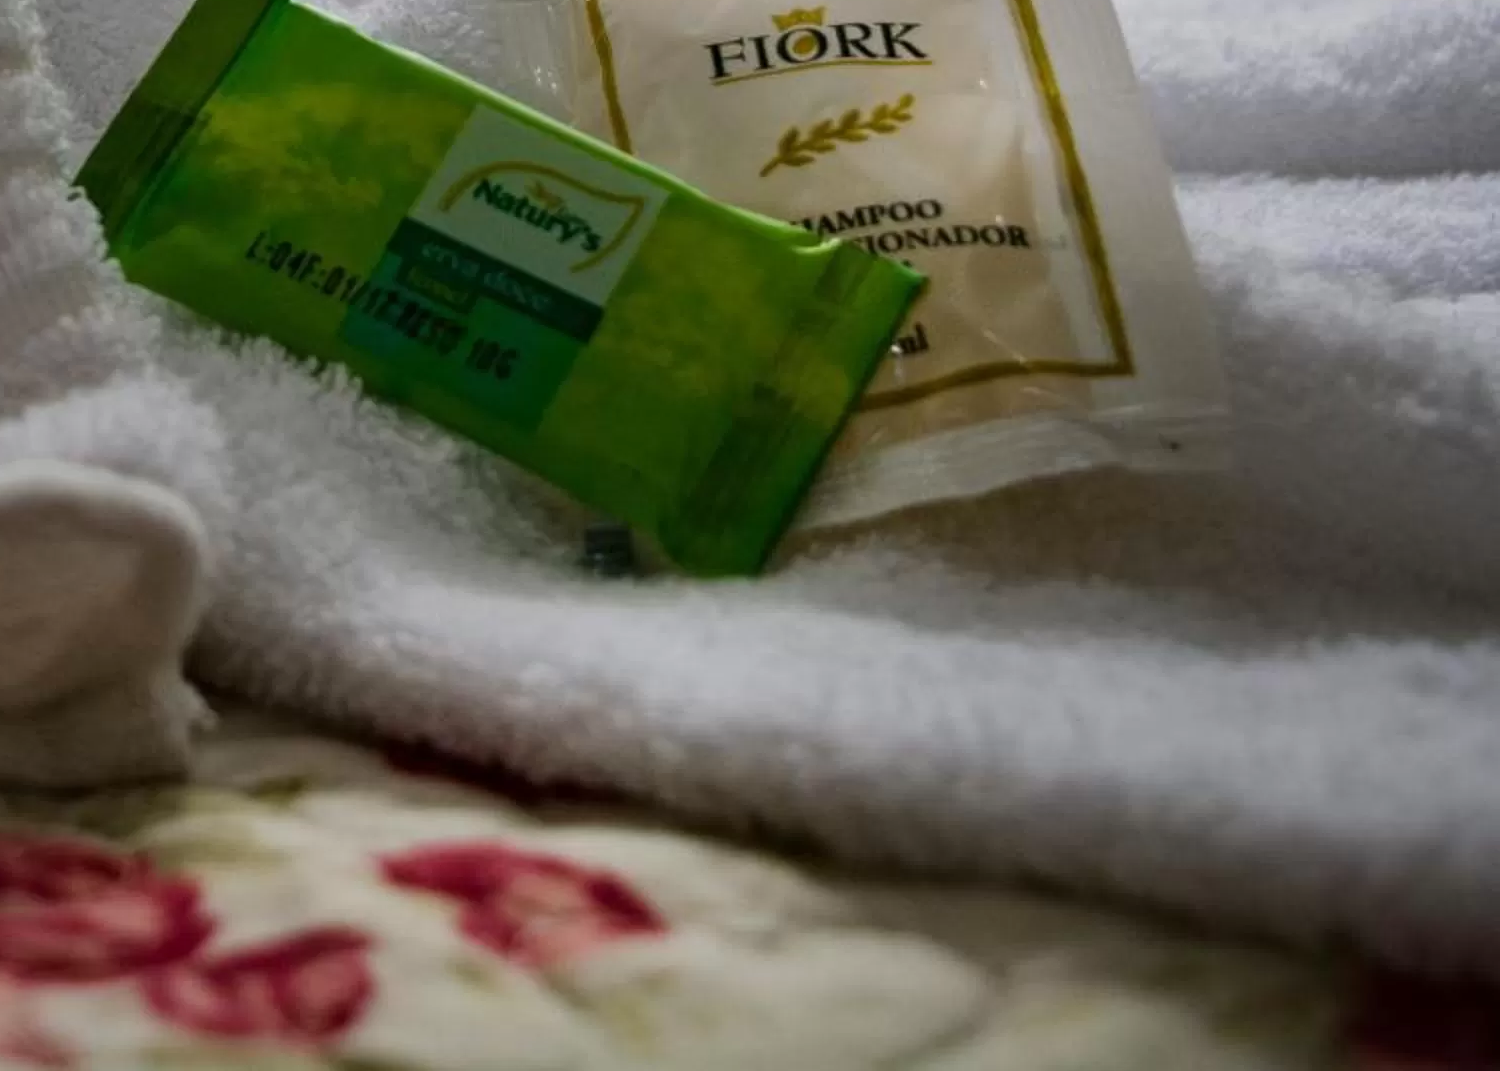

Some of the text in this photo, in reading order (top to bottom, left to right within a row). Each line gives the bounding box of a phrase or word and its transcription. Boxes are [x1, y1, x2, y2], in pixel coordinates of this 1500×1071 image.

[705, 22, 927, 79] FIORK
[472, 178, 602, 252] Natury's
[790, 199, 944, 237] AMPOO
[852, 225, 1030, 257] IONADOR
